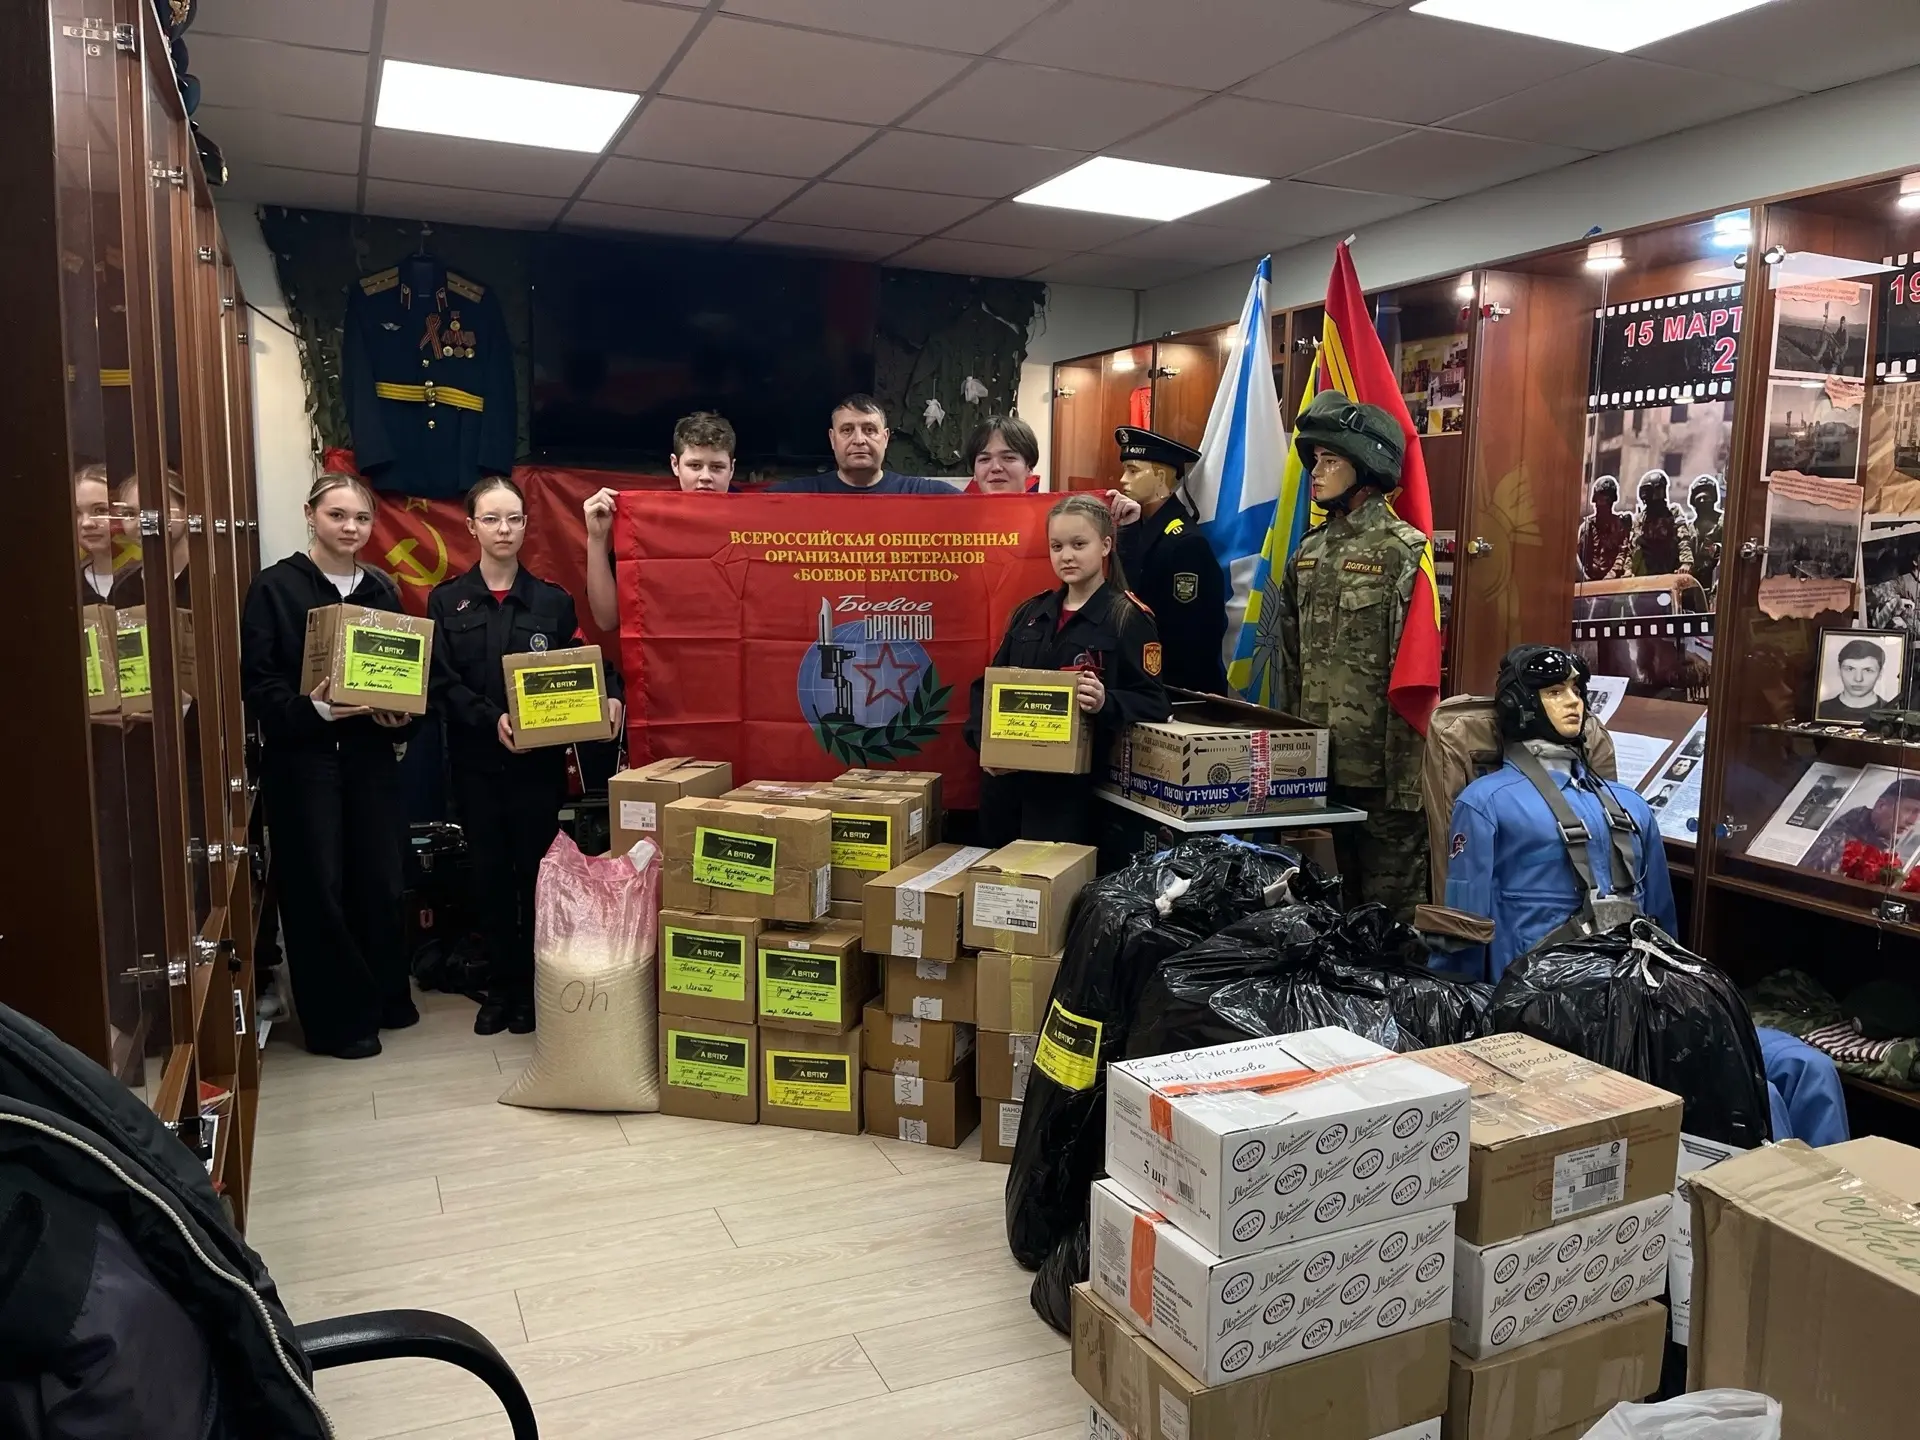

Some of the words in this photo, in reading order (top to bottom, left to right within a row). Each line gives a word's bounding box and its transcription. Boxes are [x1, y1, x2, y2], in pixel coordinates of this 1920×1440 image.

[1624, 320, 1654, 348] 15
[730, 530, 875, 546] ВСЕРОССИЙСКАЯ
[879, 532, 1019, 548] ОБЩЕСТВЕННАЯ
[765, 550, 889, 566] ОРГАНИЗАЦИЯ
[891, 551, 985, 564] ВЕТЕРАНОВ
[1345, 561, 1371, 571] ДОЛГИХ
[793, 568, 866, 582] «БОЕВОЕ
[870, 569, 960, 583] БРАТСТВО»
[835, 595, 933, 612] Боевое
[864, 614, 933, 640] БРАТСТВО
[385, 646, 404, 655] ВЯТКУ
[556, 680, 578, 688] ВЯТКУ
[849, 831, 871, 839] ВЯТКУ
[733, 850, 756, 860] ВЯТКУ
[703, 950, 725, 958] ВЯТКУ
[798, 970, 820, 979] ВЯТКУ
[707, 1052, 729, 1061] ВЯТКУ
[806, 1071, 829, 1079] ВЯТКУ
[1395, 1114, 1419, 1133] BETTY
[1320, 1128, 1344, 1147] PINK
[1434, 1135, 1456, 1154] PINK
[1236, 1145, 1262, 1166] BETTY
[1356, 1155, 1379, 1173] BETTY
[1143, 1159, 1149, 1175] 5
[1278, 1168, 1302, 1188] PINK
[1394, 1180, 1418, 1200] BETTY
[1318, 1196, 1342, 1216] PINK
[1236, 1215, 1262, 1236] BETTY
[1381, 1237, 1404, 1257] BETTY
[1306, 1256, 1330, 1276] PINK
[1419, 1256, 1441, 1276] PINK
[1225, 1277, 1250, 1298] BETTY
[1343, 1280, 1366, 1300] BETTY
[1266, 1298, 1290, 1318] PINK
[1379, 1303, 1402, 1323] BETTY
[1305, 1323, 1328, 1343] PINK
[1224, 1345, 1250, 1366] BETTY
